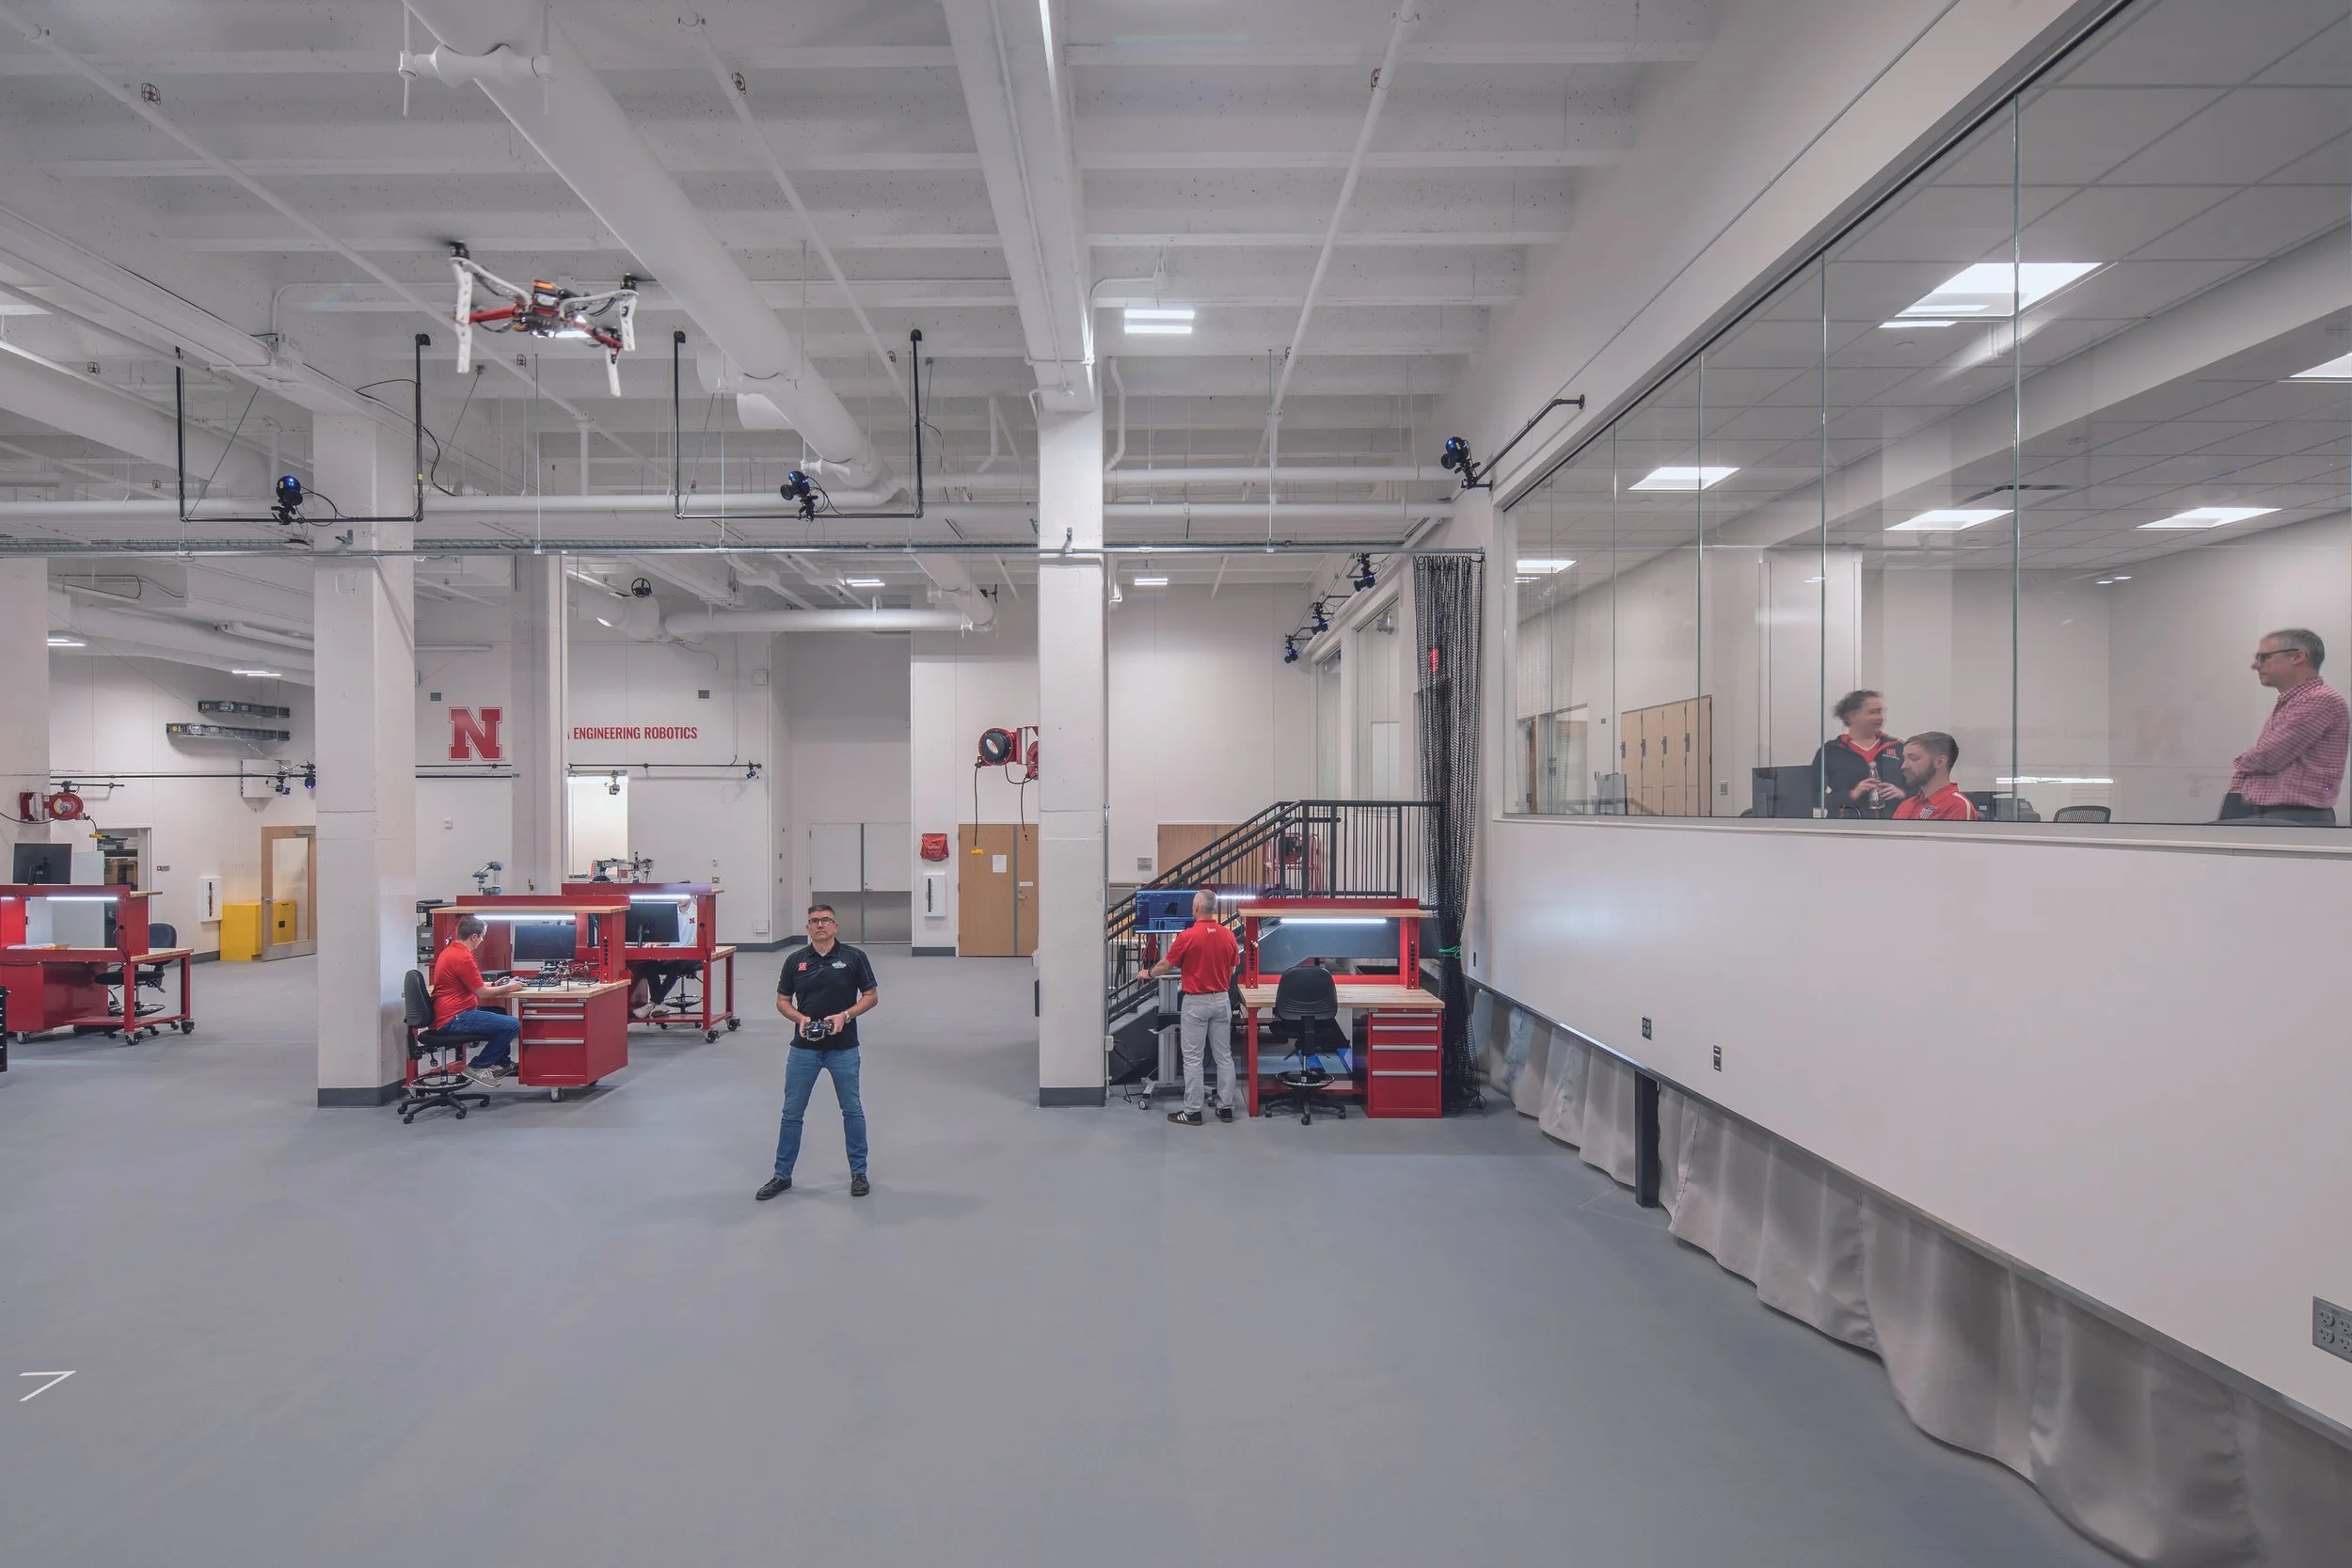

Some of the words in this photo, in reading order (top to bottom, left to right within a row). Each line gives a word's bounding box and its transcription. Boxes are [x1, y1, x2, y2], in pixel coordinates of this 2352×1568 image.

[449, 707, 502, 761] N
[573, 727, 641, 739] ENGINEERING
[644, 727, 698, 739] ROBOTICS
